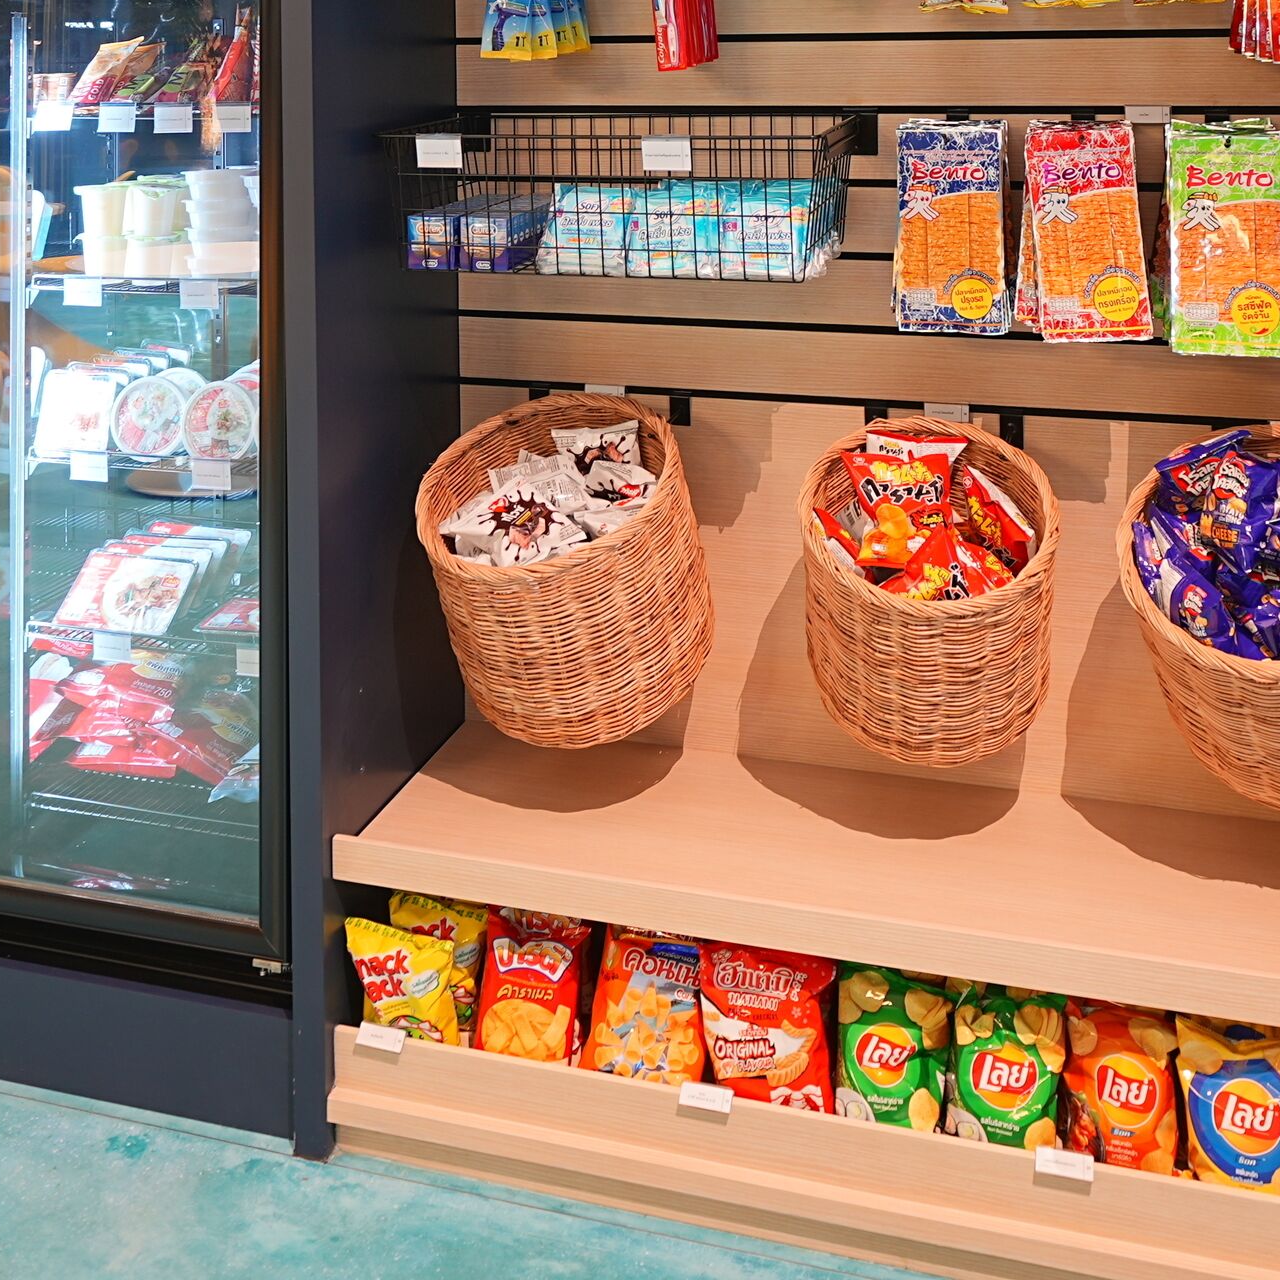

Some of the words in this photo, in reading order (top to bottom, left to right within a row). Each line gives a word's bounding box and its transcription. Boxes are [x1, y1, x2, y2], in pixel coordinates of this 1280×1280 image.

[657, 25, 666, 64] Colgate
[910, 157, 986, 182] Bento
[1041, 161, 1123, 185] Bento
[1185, 165, 1275, 190] Bento
[579, 202, 601, 211] SOFY
[1212, 526, 1239, 543] CHEESE
[365, 974, 407, 1003] ack
[497, 983, 555, 1000] คาราเมล
[715, 1038, 776, 1058] ORIGINAL
[862, 1034, 917, 1069] เลย์
[978, 1054, 1031, 1093] เลย์
[1102, 1067, 1150, 1108] เลย์
[1221, 1093, 1275, 1135] เลย์
